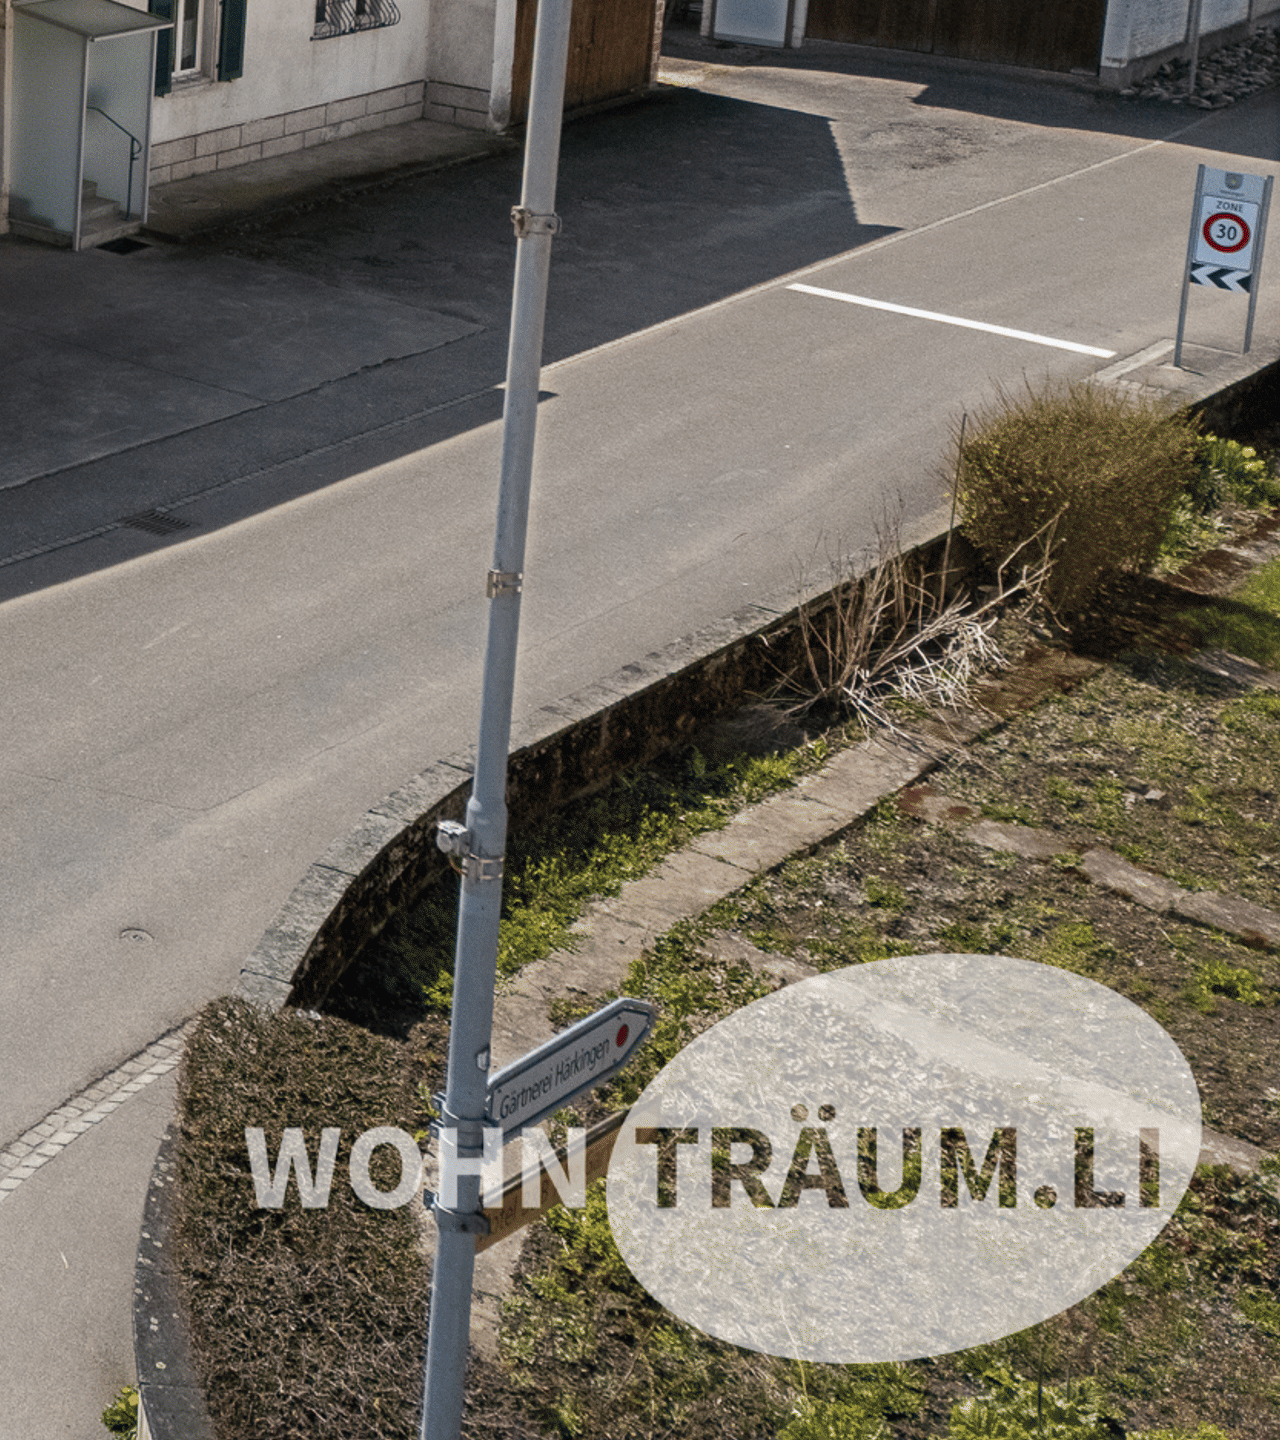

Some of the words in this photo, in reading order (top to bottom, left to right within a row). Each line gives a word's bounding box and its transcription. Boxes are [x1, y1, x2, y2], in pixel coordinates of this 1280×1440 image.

[1216, 200, 1243, 213] ZONE
[1216, 223, 1237, 241] 30
[500, 1067, 553, 1119] Gärtnerei
[556, 1038, 610, 1086] Härkingen
